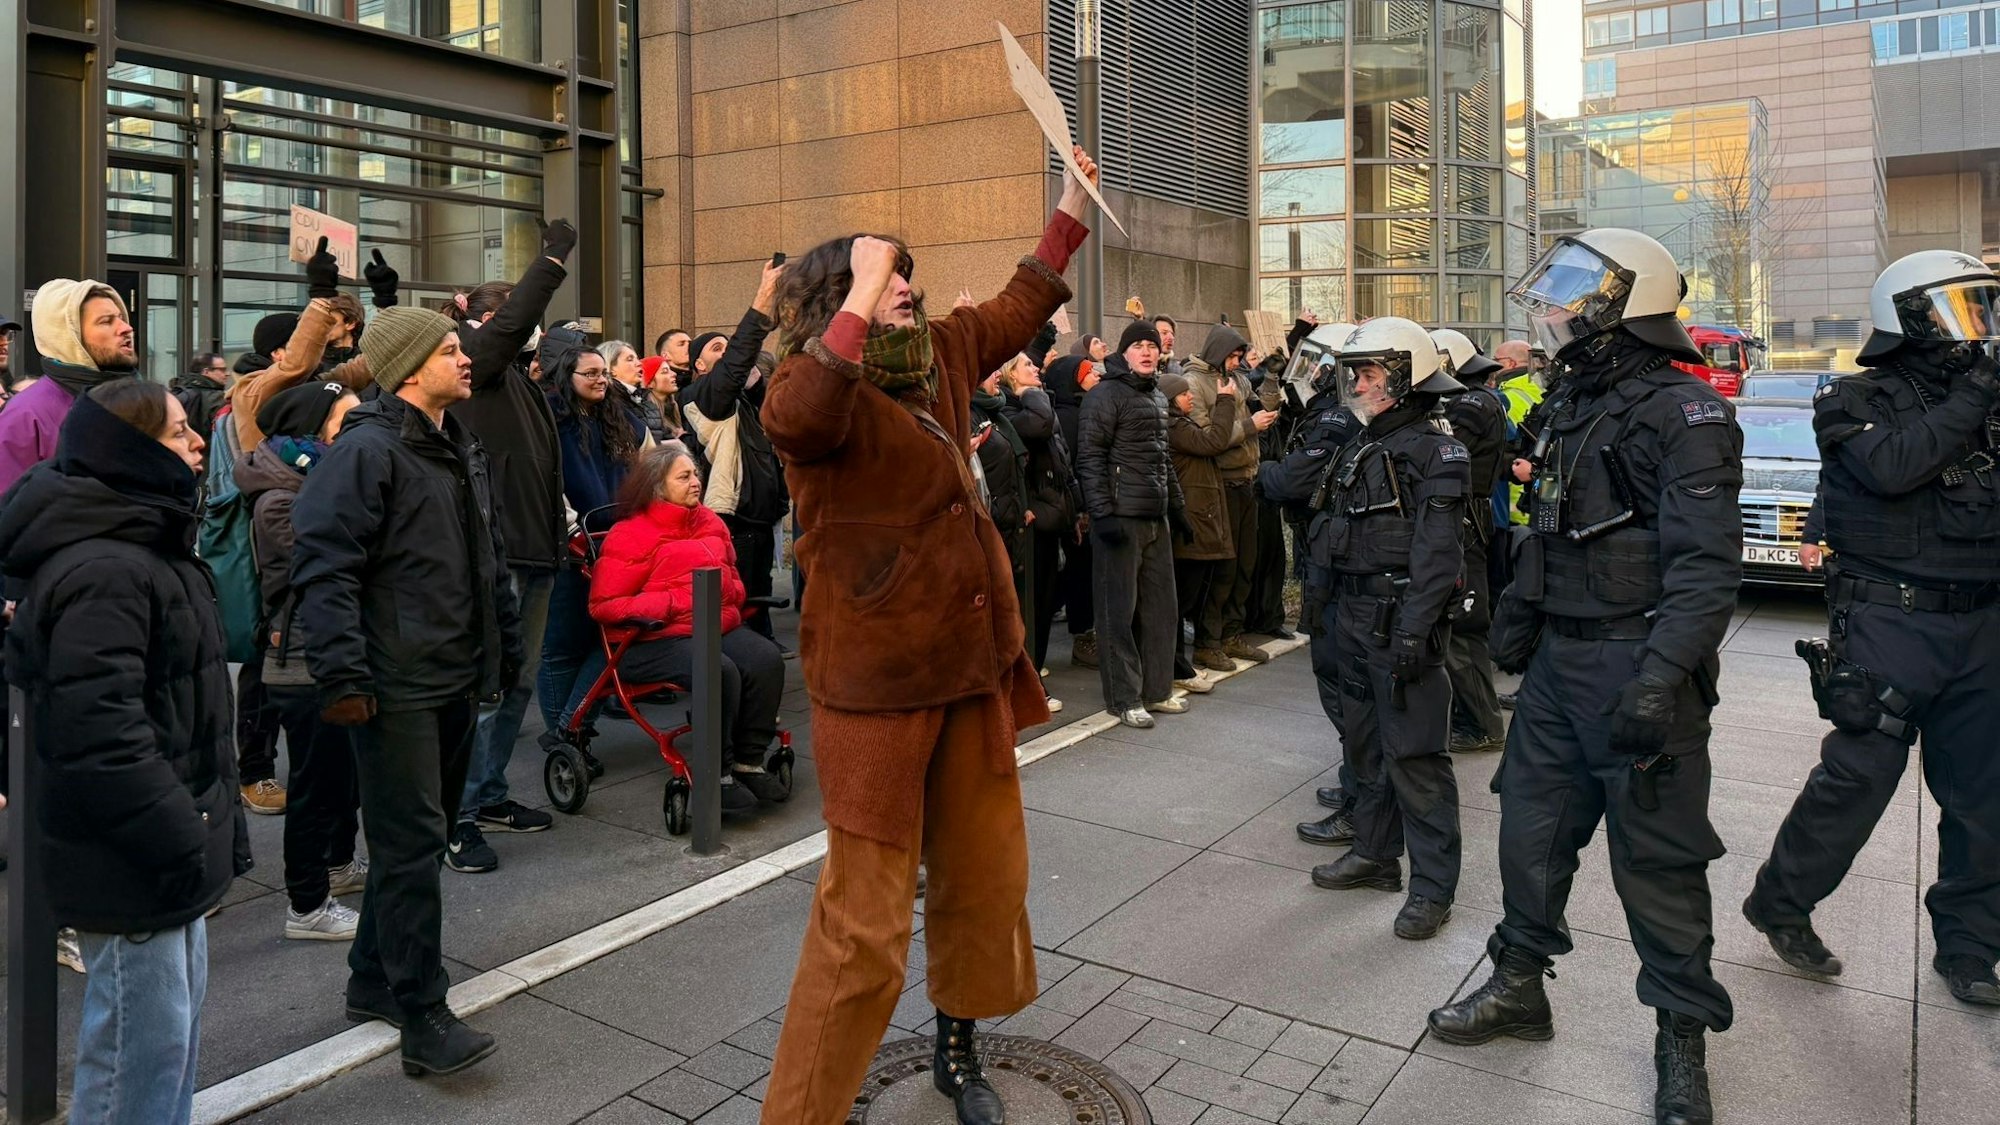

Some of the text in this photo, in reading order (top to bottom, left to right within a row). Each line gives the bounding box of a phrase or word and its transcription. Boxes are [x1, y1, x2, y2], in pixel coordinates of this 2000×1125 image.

[295, 211, 321, 232] CDU
[1748, 548, 1799, 562] D KC 5
